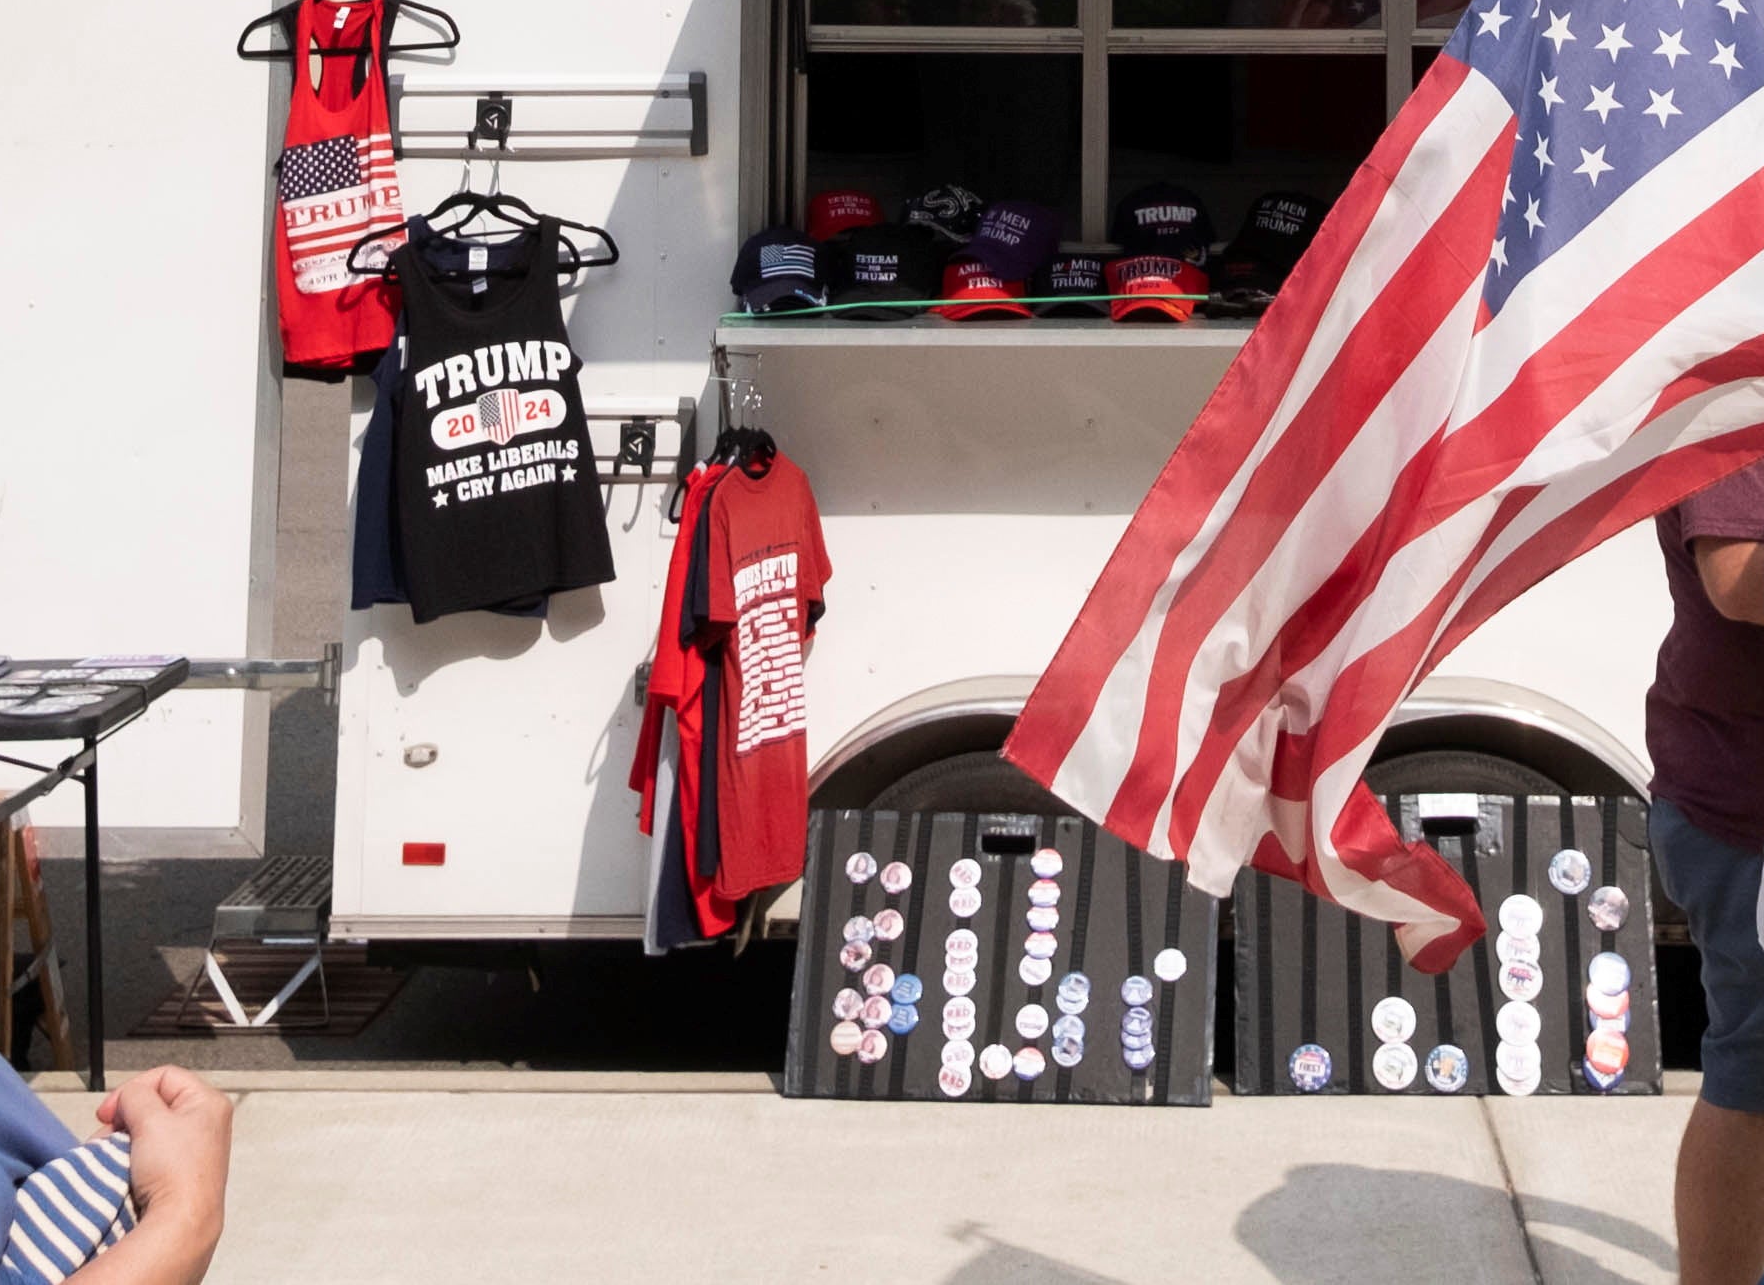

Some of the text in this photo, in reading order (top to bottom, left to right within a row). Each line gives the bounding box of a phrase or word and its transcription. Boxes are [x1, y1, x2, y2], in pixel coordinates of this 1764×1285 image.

[288, 186, 400, 227] TRUMP
[1134, 206, 1197, 225] TRUMP
[855, 271, 897, 281] TRUMP
[1052, 276, 1097, 289] TRUMP
[1116, 259, 1182, 280] TRUMP
[415, 341, 571, 408] TRUMP
[426, 440, 578, 487] MAKE LIBERALS
[457, 465, 556, 502] CRY AGAIN
